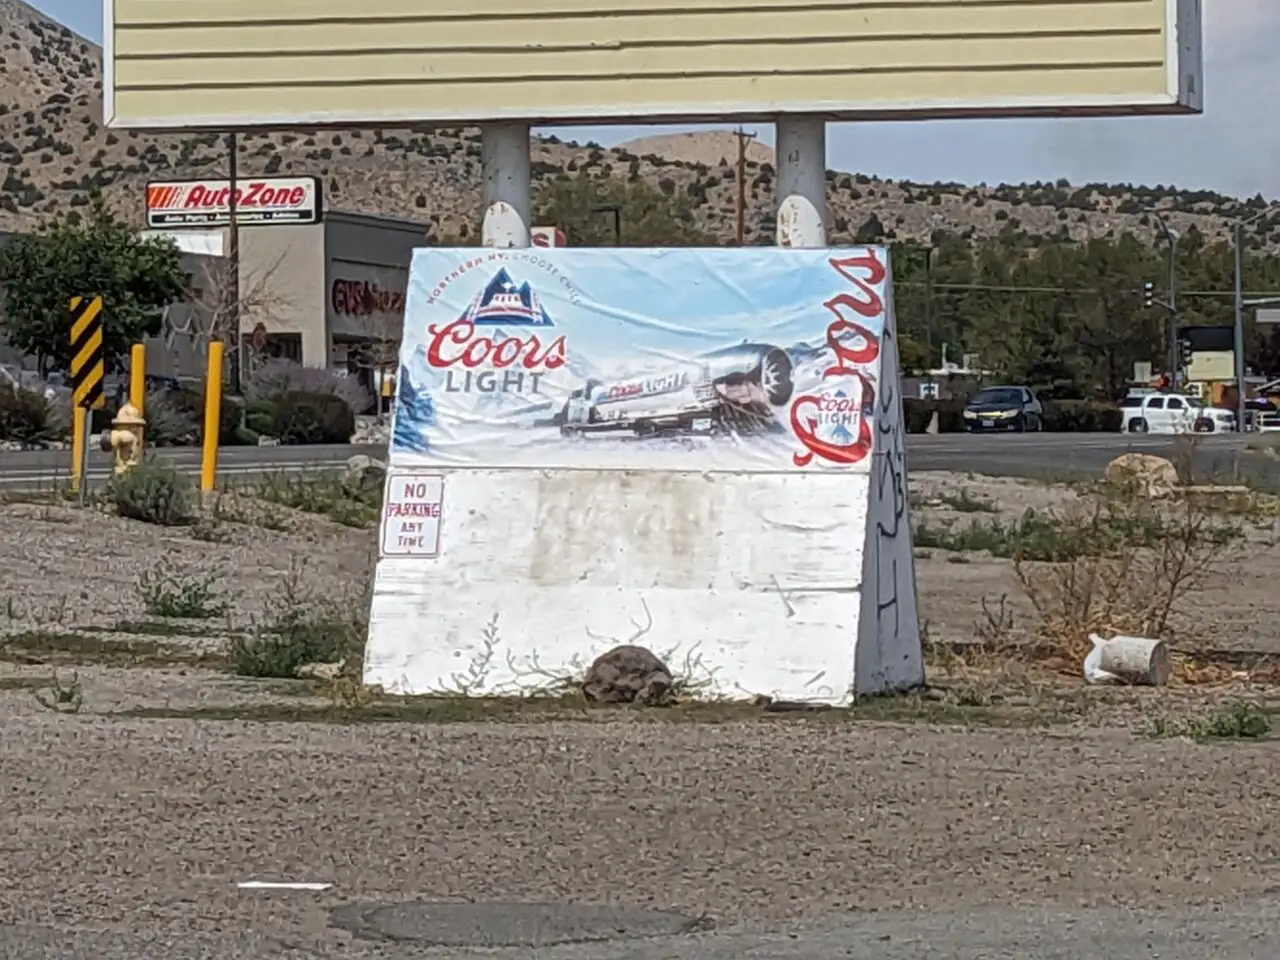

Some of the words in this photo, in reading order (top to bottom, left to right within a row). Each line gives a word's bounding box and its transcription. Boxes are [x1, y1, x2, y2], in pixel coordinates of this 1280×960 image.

[184, 183, 306, 208] AutoZone
[426, 319, 567, 369] Coors
[445, 371, 545, 394] LIGHT
[404, 483, 427, 499] NO
[387, 503, 441, 518] PARKING
[397, 536, 425, 548] TIME
